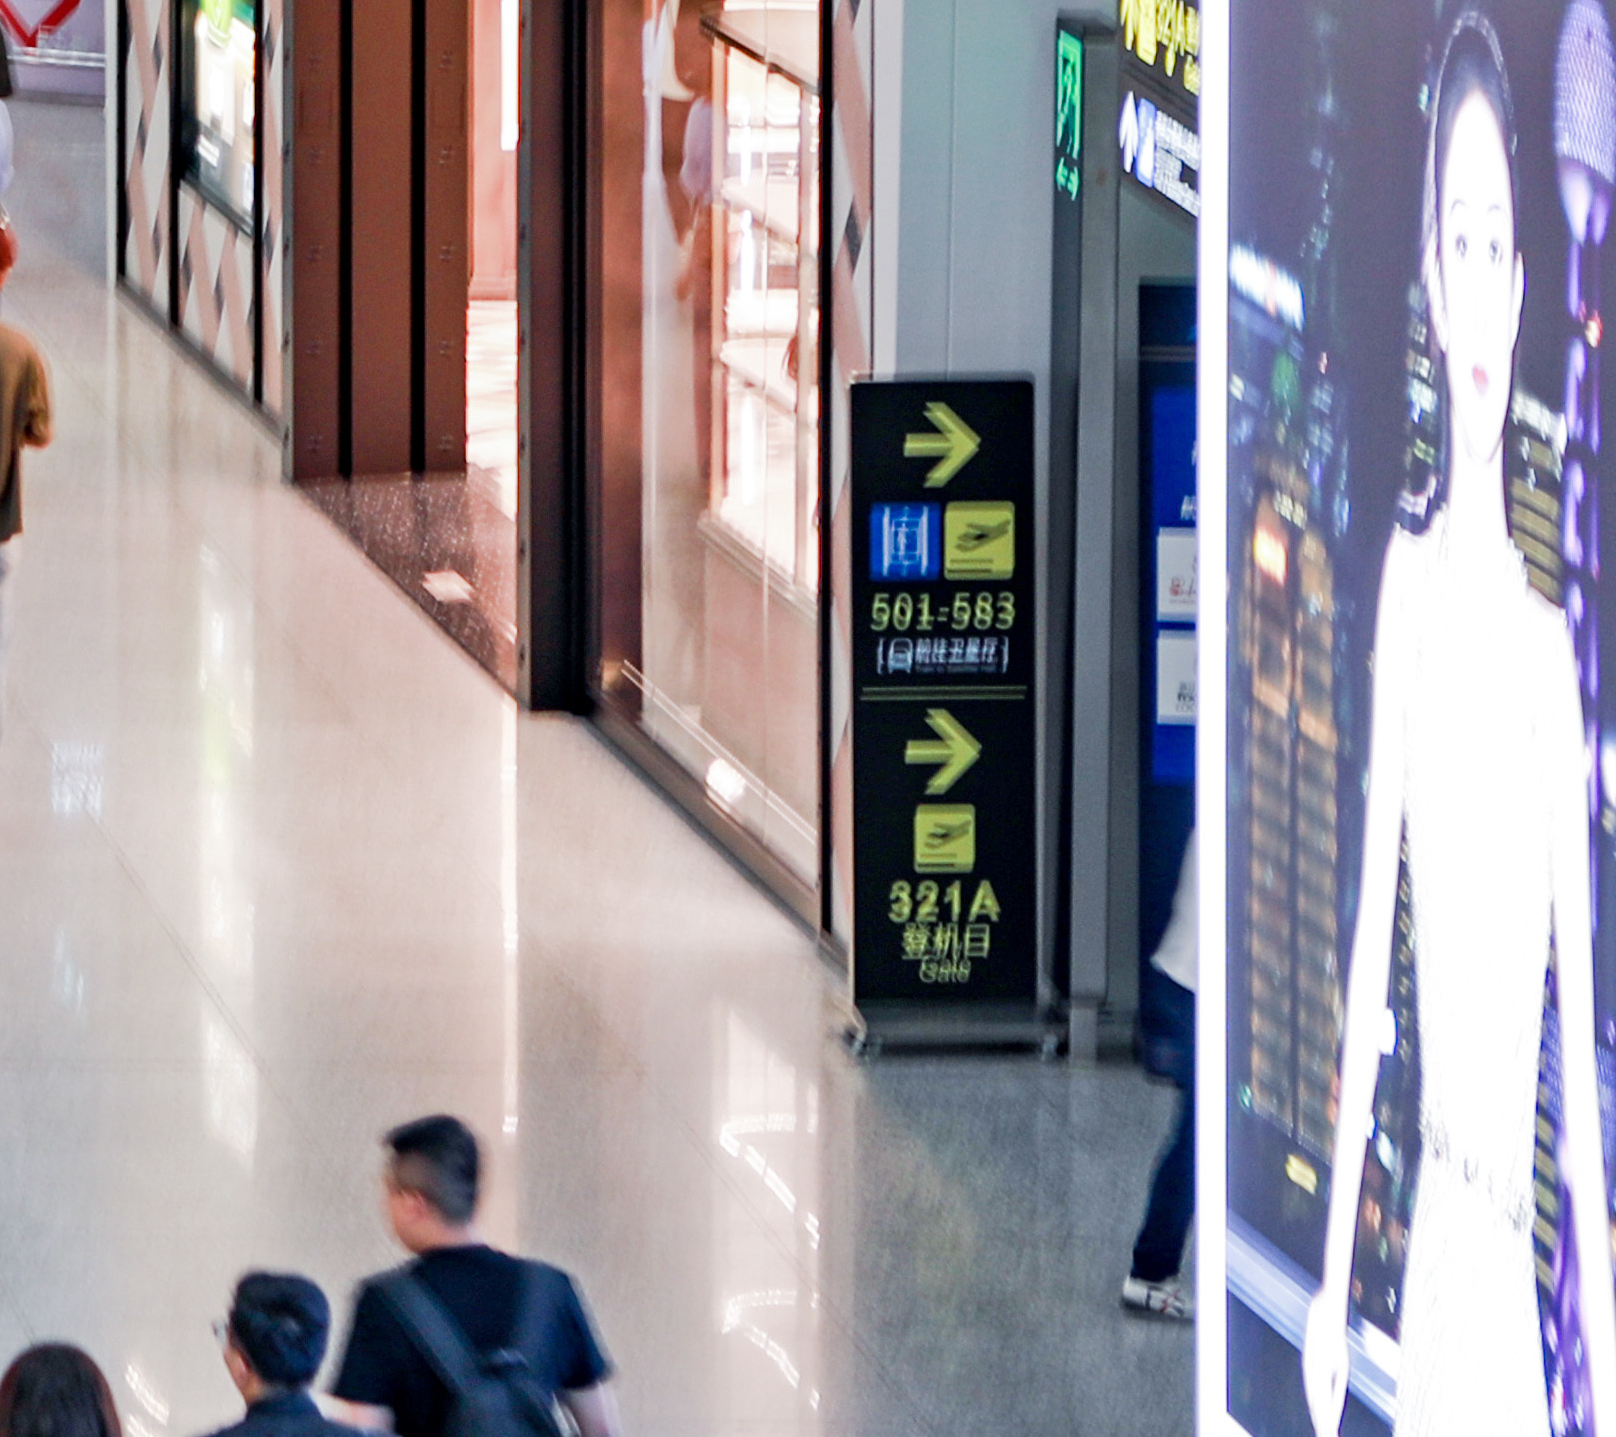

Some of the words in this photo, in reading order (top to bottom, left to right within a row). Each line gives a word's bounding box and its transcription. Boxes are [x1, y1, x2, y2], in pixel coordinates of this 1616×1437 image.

[870, 591, 1016, 631] 501-583
[888, 879, 1002, 924] 321A
[918, 954, 972, 984] Gate
